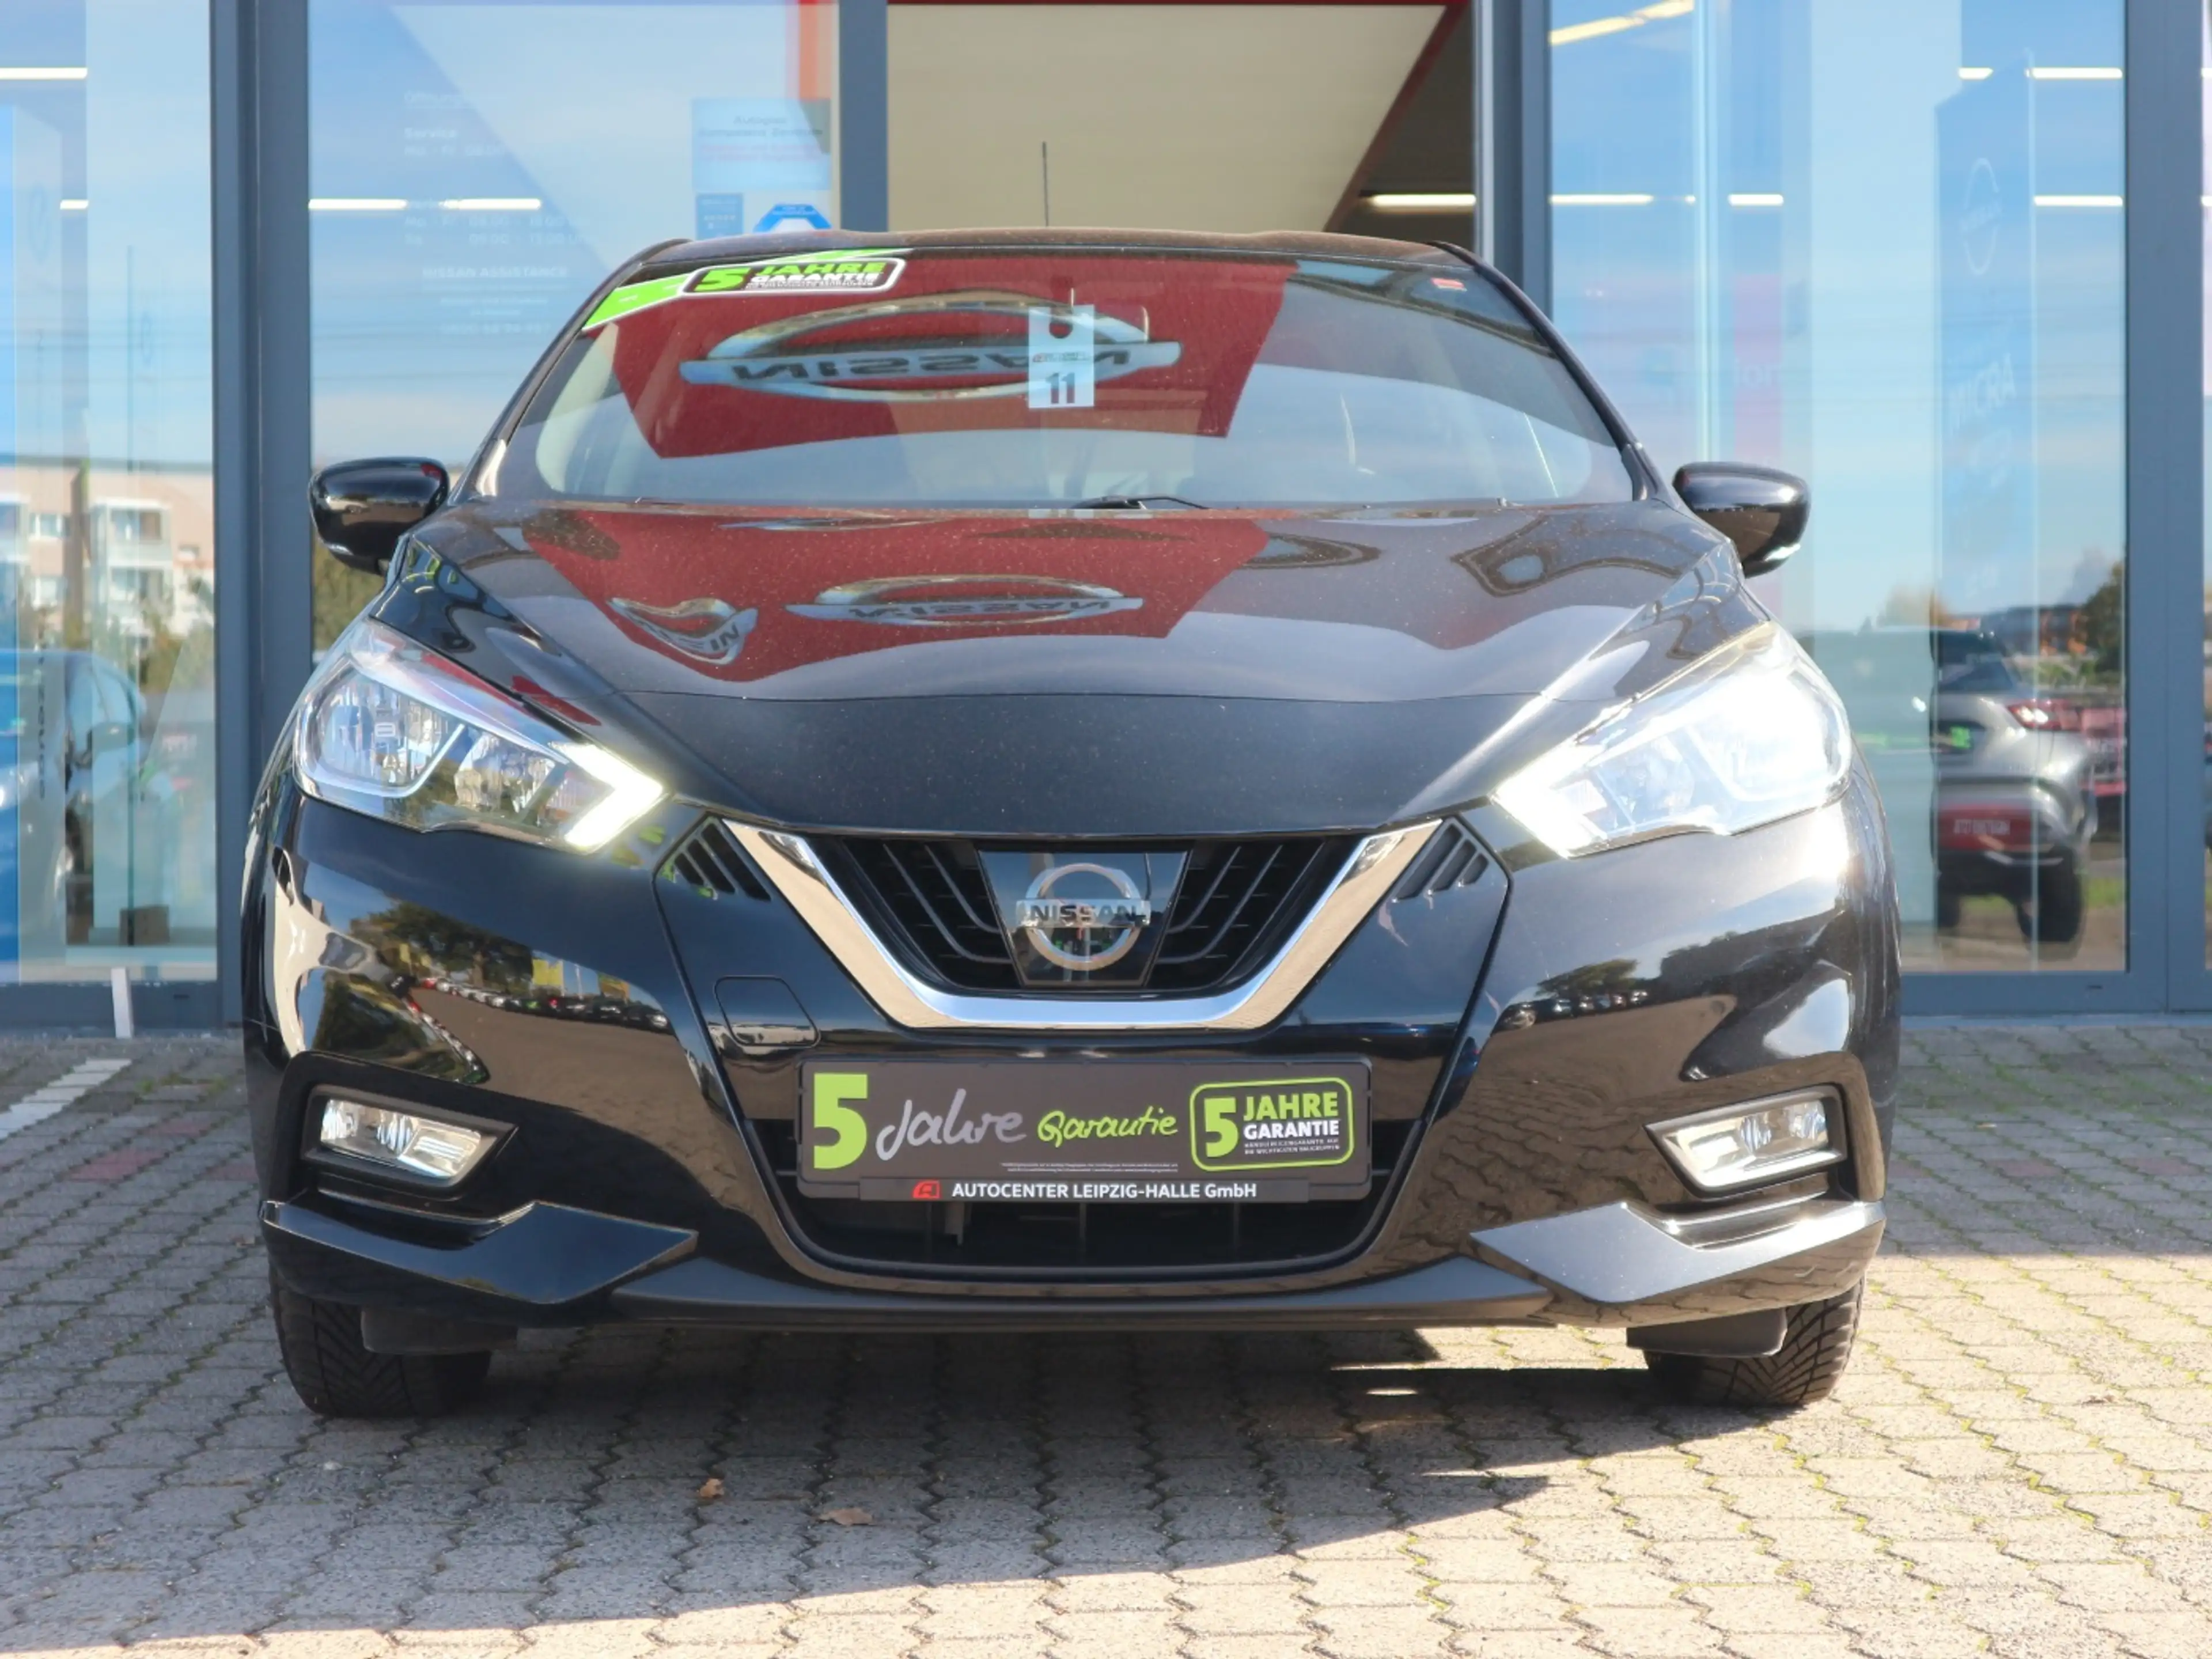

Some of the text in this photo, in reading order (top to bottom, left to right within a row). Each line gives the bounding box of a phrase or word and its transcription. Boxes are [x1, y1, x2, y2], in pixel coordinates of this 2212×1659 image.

[695, 268, 750, 291] 5
[755, 262, 887, 275] JAHRE
[1046, 373, 1075, 404] 11
[1030, 904, 1137, 922] NISSAN
[814, 1073, 868, 1169] 5
[876, 1088, 1027, 1161] Jahre
[1204, 1092, 1339, 1158] 5 JAHRE
[1244, 1120, 1340, 1140] GARANTIE
[952, 1183, 1257, 1199] AUTOCENTER LEIPZIG-HALLE GmbH
